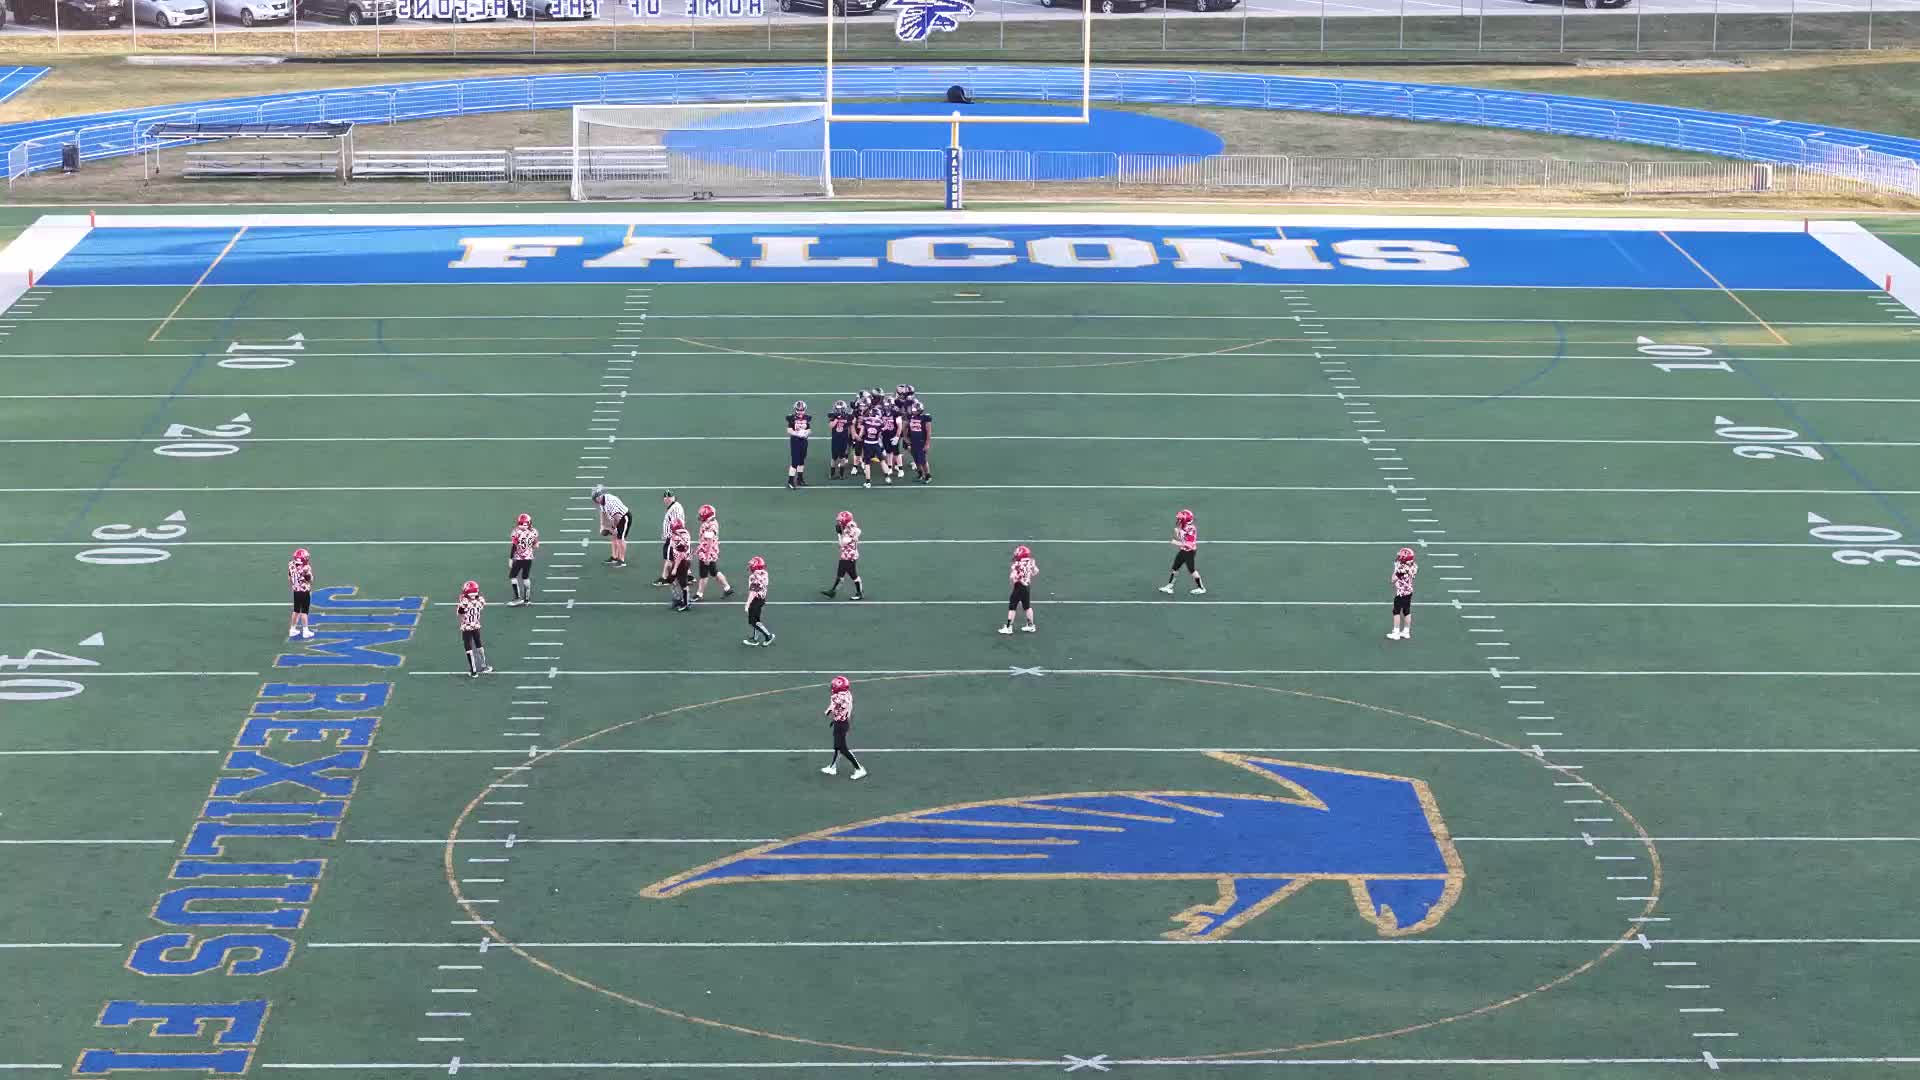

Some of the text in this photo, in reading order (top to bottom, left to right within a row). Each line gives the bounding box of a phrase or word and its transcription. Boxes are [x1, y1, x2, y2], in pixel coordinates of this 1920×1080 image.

[448, 236, 1470, 271] FALCONS
[217, 342, 304, 369] 10
[1637, 344, 1735, 373] 10
[153, 424, 251, 457] 20
[1715, 426, 1824, 460] 20
[75, 524, 187, 564] 30
[1809, 525, 1920, 567] 30
[0, 648, 101, 700] 40
[68, 584, 429, 1080] JIM REXILIUS FI
